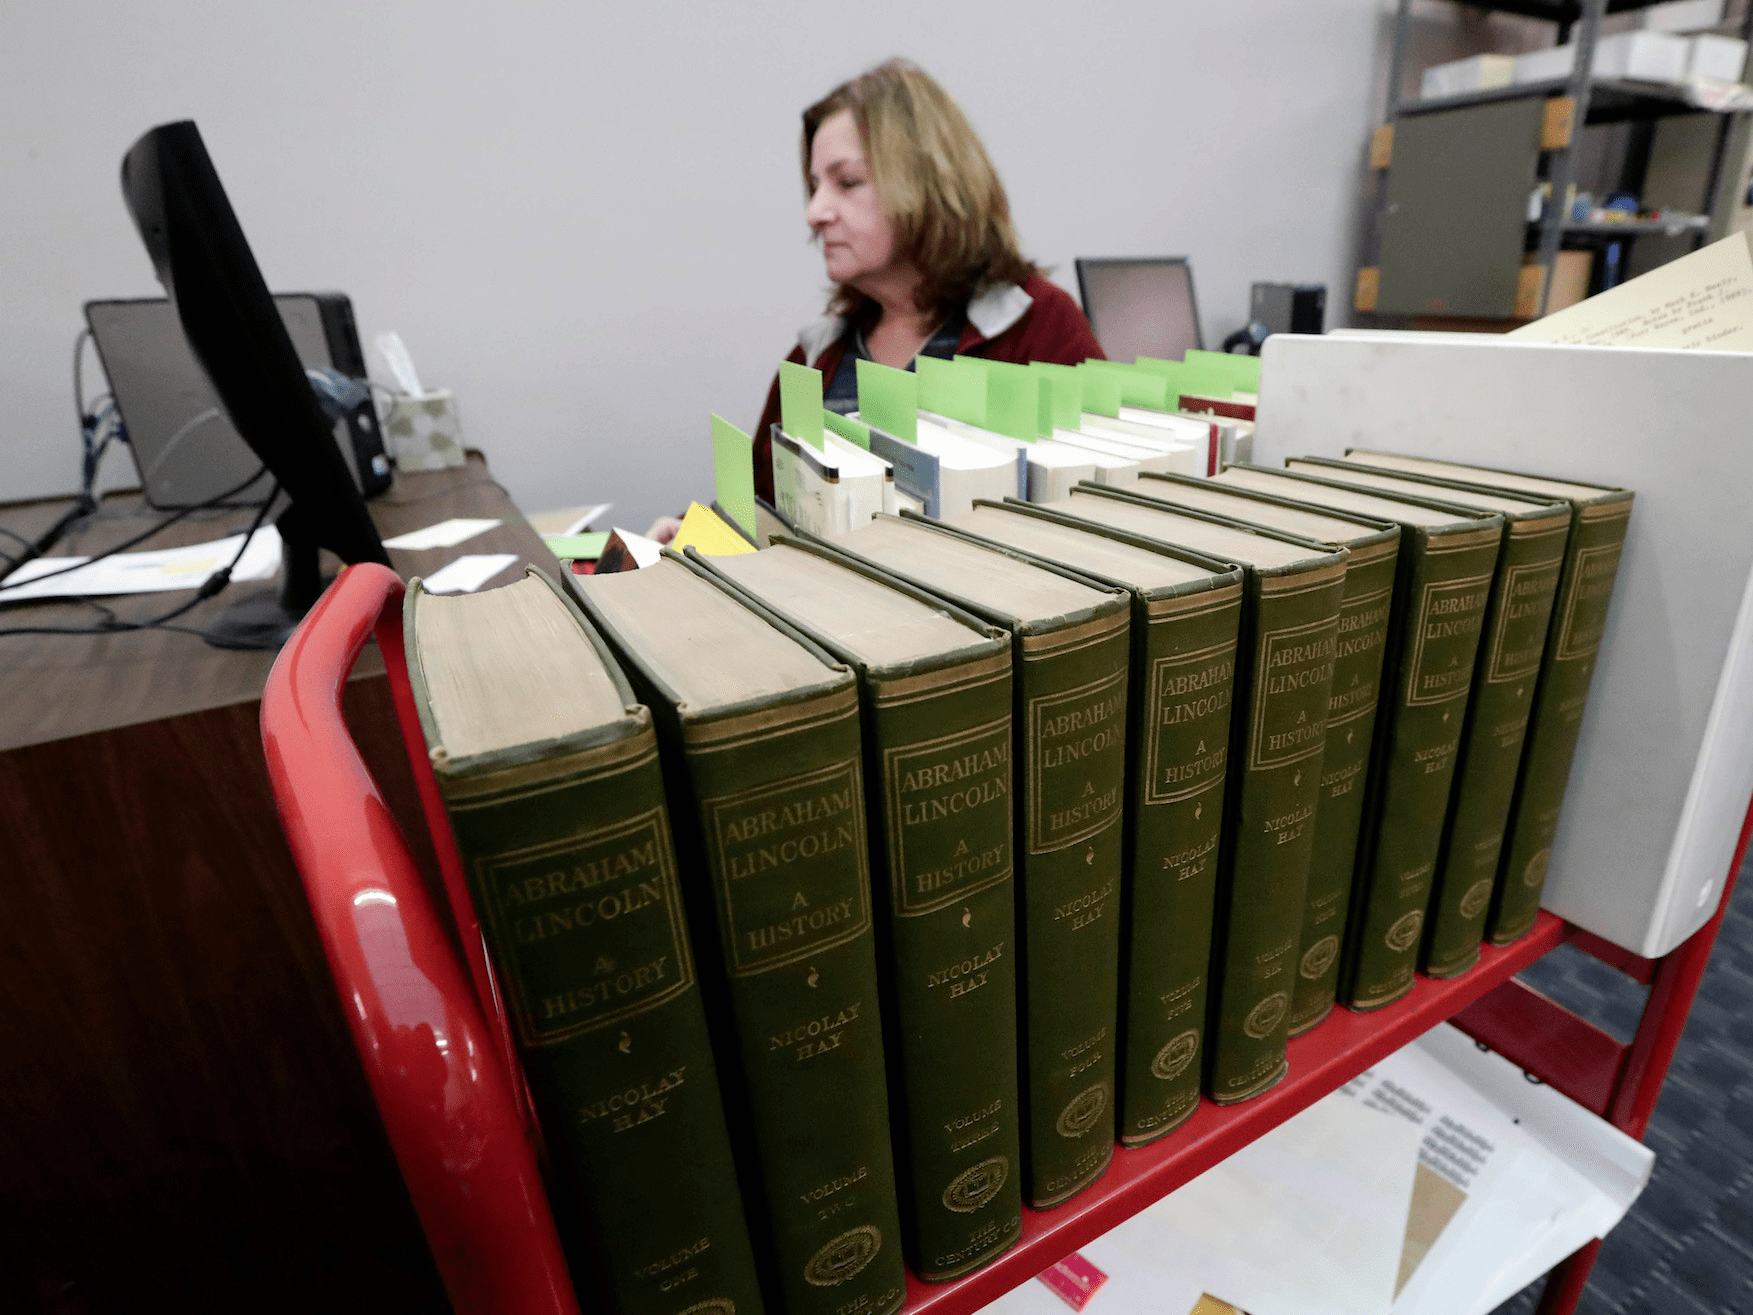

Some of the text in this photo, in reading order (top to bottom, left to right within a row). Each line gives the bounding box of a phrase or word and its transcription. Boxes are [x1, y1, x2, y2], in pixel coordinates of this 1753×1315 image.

[1338, 605, 1386, 633] BRAHAM
[1335, 629, 1384, 658] INCOLN
[1296, 710, 1307, 725] A
[1165, 747, 1225, 784] HISTORY
[1195, 740, 1206, 755] A
[900, 741, 1008, 794] ABRAHAM
[903, 772, 1008, 826] LINCOLN
[1081, 781, 1096, 798] A
[724, 787, 852, 846] ABRAHAM
[1050, 786, 1117, 831] HISTORY
[729, 820, 853, 881] LINCOLN
[953, 839, 970, 858] A
[1163, 833, 1217, 870] NICOLAY
[505, 840, 657, 906] ABRAHAM
[916, 843, 1005, 893] HISTORY
[1178, 859, 1206, 882] HAY
[514, 875, 661, 943] LINCOLN
[792, 891, 810, 911] A
[1054, 879, 1114, 920] NICOLAY
[1071, 903, 1104, 931] HAY
[747, 896, 854, 951] HISTORY
[927, 941, 1005, 989] NICOLAY
[543, 955, 667, 1019] HISTORY
[949, 969, 990, 999] HAY
[769, 1001, 861, 1051] NICOLAY
[796, 1030, 844, 1062] HAY
[580, 1066, 686, 1124] NICOLAY
[612, 1097, 668, 1134] HAY
[944, 1098, 1002, 1133] VOLUME
